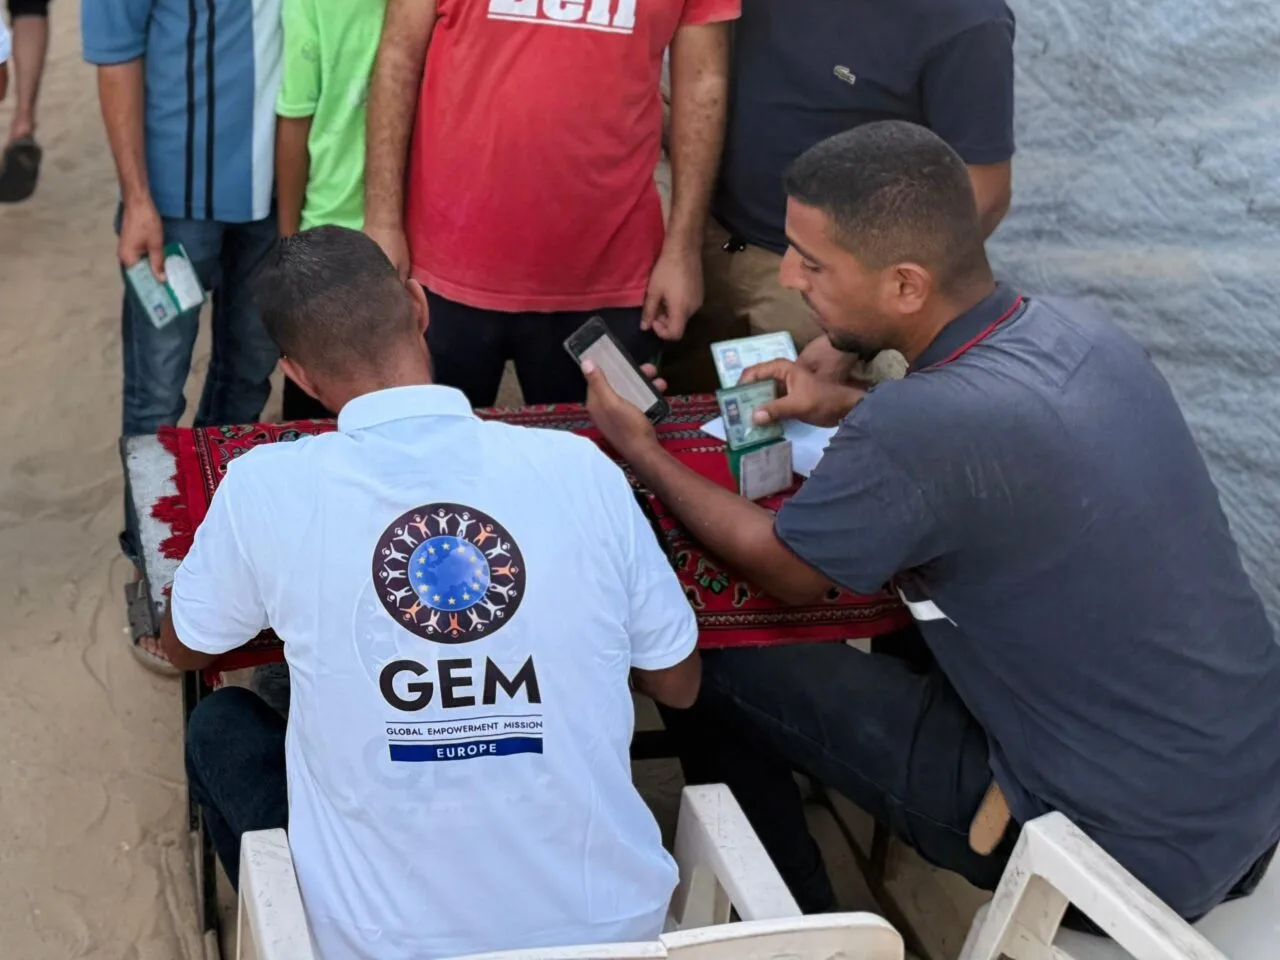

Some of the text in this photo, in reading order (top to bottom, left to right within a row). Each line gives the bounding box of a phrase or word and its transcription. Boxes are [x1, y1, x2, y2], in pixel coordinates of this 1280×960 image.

[379, 654, 542, 712] GEM
[386, 721, 543, 736] GLOBAL EMPOWERMENT MISSION
[436, 743, 497, 758] EUROPE
